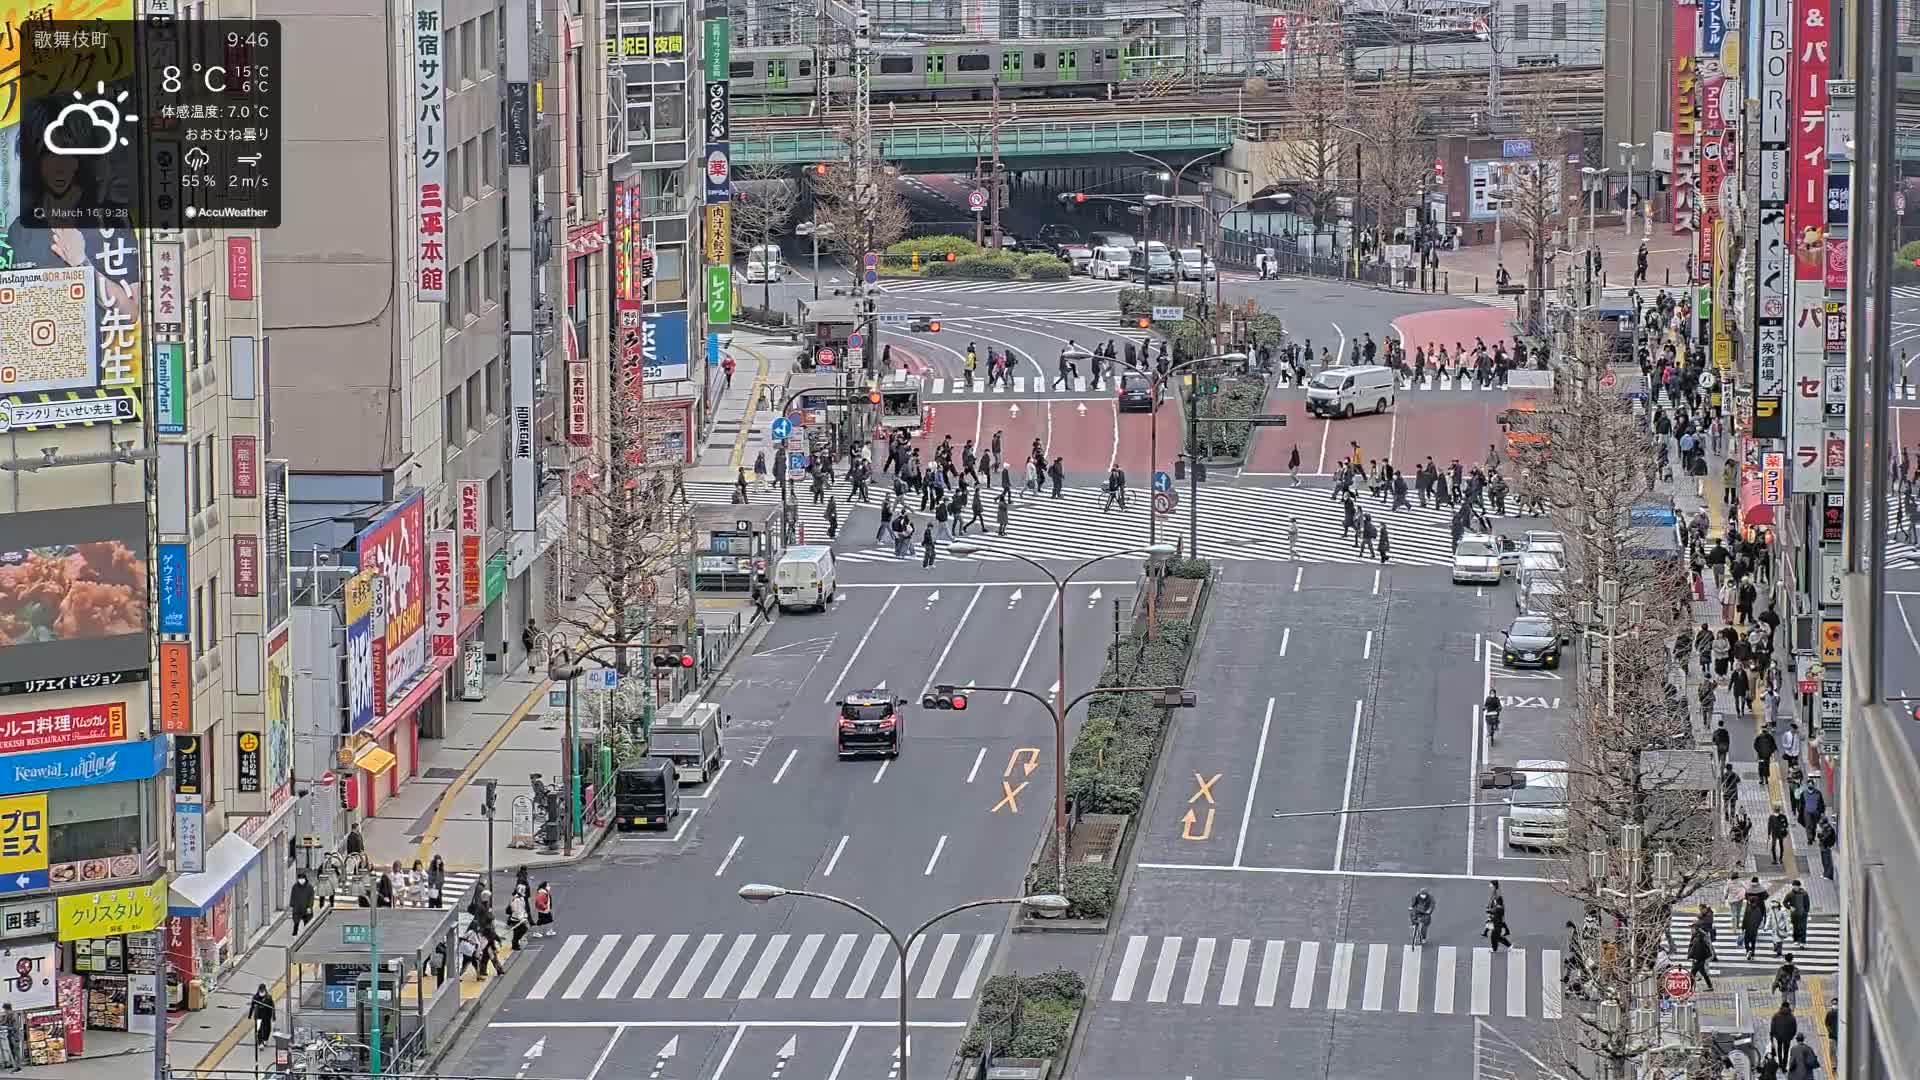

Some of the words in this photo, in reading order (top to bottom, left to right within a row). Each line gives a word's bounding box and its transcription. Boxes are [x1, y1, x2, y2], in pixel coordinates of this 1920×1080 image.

[622, 36, 648, 54] 祝日
[655, 35, 683, 54] 夜間
[418, 10, 441, 169] 新宿サンパーク
[710, 84, 725, 138] もつなべ
[1707, 86, 1720, 119] アコム
[1801, 8, 1827, 203] &パーティー
[709, 160, 727, 177] 薬
[1771, 152, 1779, 200] ESOLA
[420, 183, 443, 291] 三平本館
[1703, 227, 1711, 257] RESALE
[711, 275, 726, 313] レイク
[1827, 303, 1837, 311] 6F
[159, 323, 177, 332] 3F
[1761, 329, 1775, 381] 大衆酒場
[158, 352, 170, 414] FamilyMart
[1798, 306, 1823, 468] パセラ
[15, 410, 51, 420] テンクリ
[55, 405, 113, 417] たいせい先生
[1831, 404, 1844, 413] 5F
[515, 407, 529, 459] HOMEGAME
[1765, 454, 1780, 468] 薬
[462, 486, 474, 530] GAME
[714, 540, 727, 552] 10
[435, 541, 451, 628] 三平ストア
[110, 710, 121, 736] 5F
[167, 719, 184, 729] B2
[26, 734, 71, 746] RESTAURANT
[244, 734, 255, 750] 占
[1, 810, 41, 833] プロ
[2, 834, 41, 857] ミス
[6, 910, 41, 930] 囲碁
[72, 902, 144, 926] クリスタル
[328, 990, 344, 1003] 12
